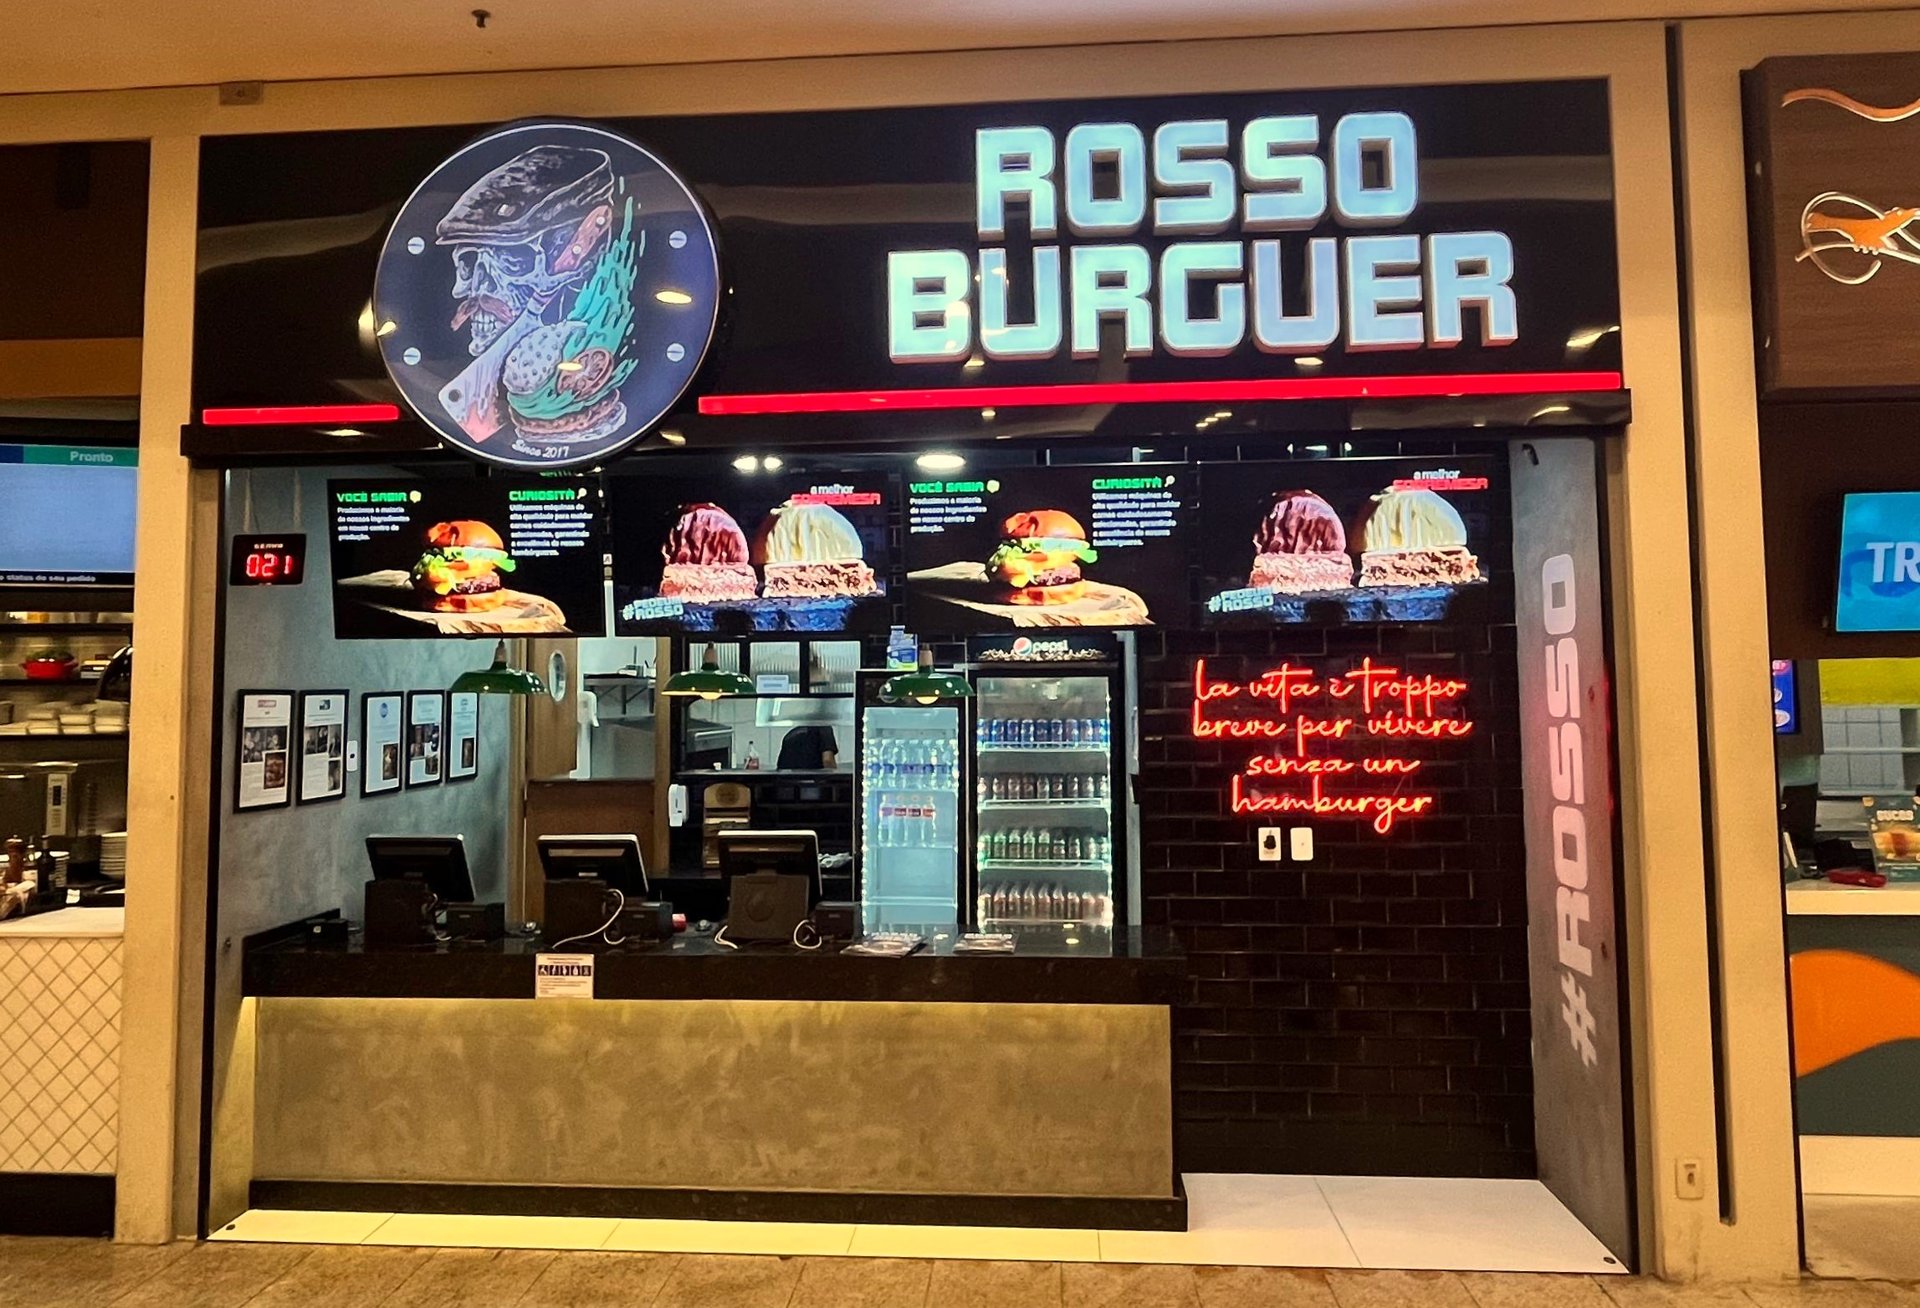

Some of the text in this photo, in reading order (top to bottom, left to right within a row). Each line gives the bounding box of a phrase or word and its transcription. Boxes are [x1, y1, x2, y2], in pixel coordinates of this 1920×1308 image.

[975, 111, 1419, 239] ROSSO
[888, 230, 1519, 364] BURGUER
[70, 451, 114, 463] Pronto
[511, 439, 570, 458] Since 2017
[1422, 469, 1460, 480] melhor
[818, 484, 854, 495] melhor
[246, 553, 293, 578] 021
[635, 605, 684, 620] ROSSO
[1222, 595, 1274, 612] ROSSO
[1250, 663, 1320, 713] vita
[1345, 657, 1466, 717] troppo
[1192, 699, 1473, 757] breve per vivere
[1246, 755, 1421, 776] senza un
[1232, 774, 1433, 834] hamburger
